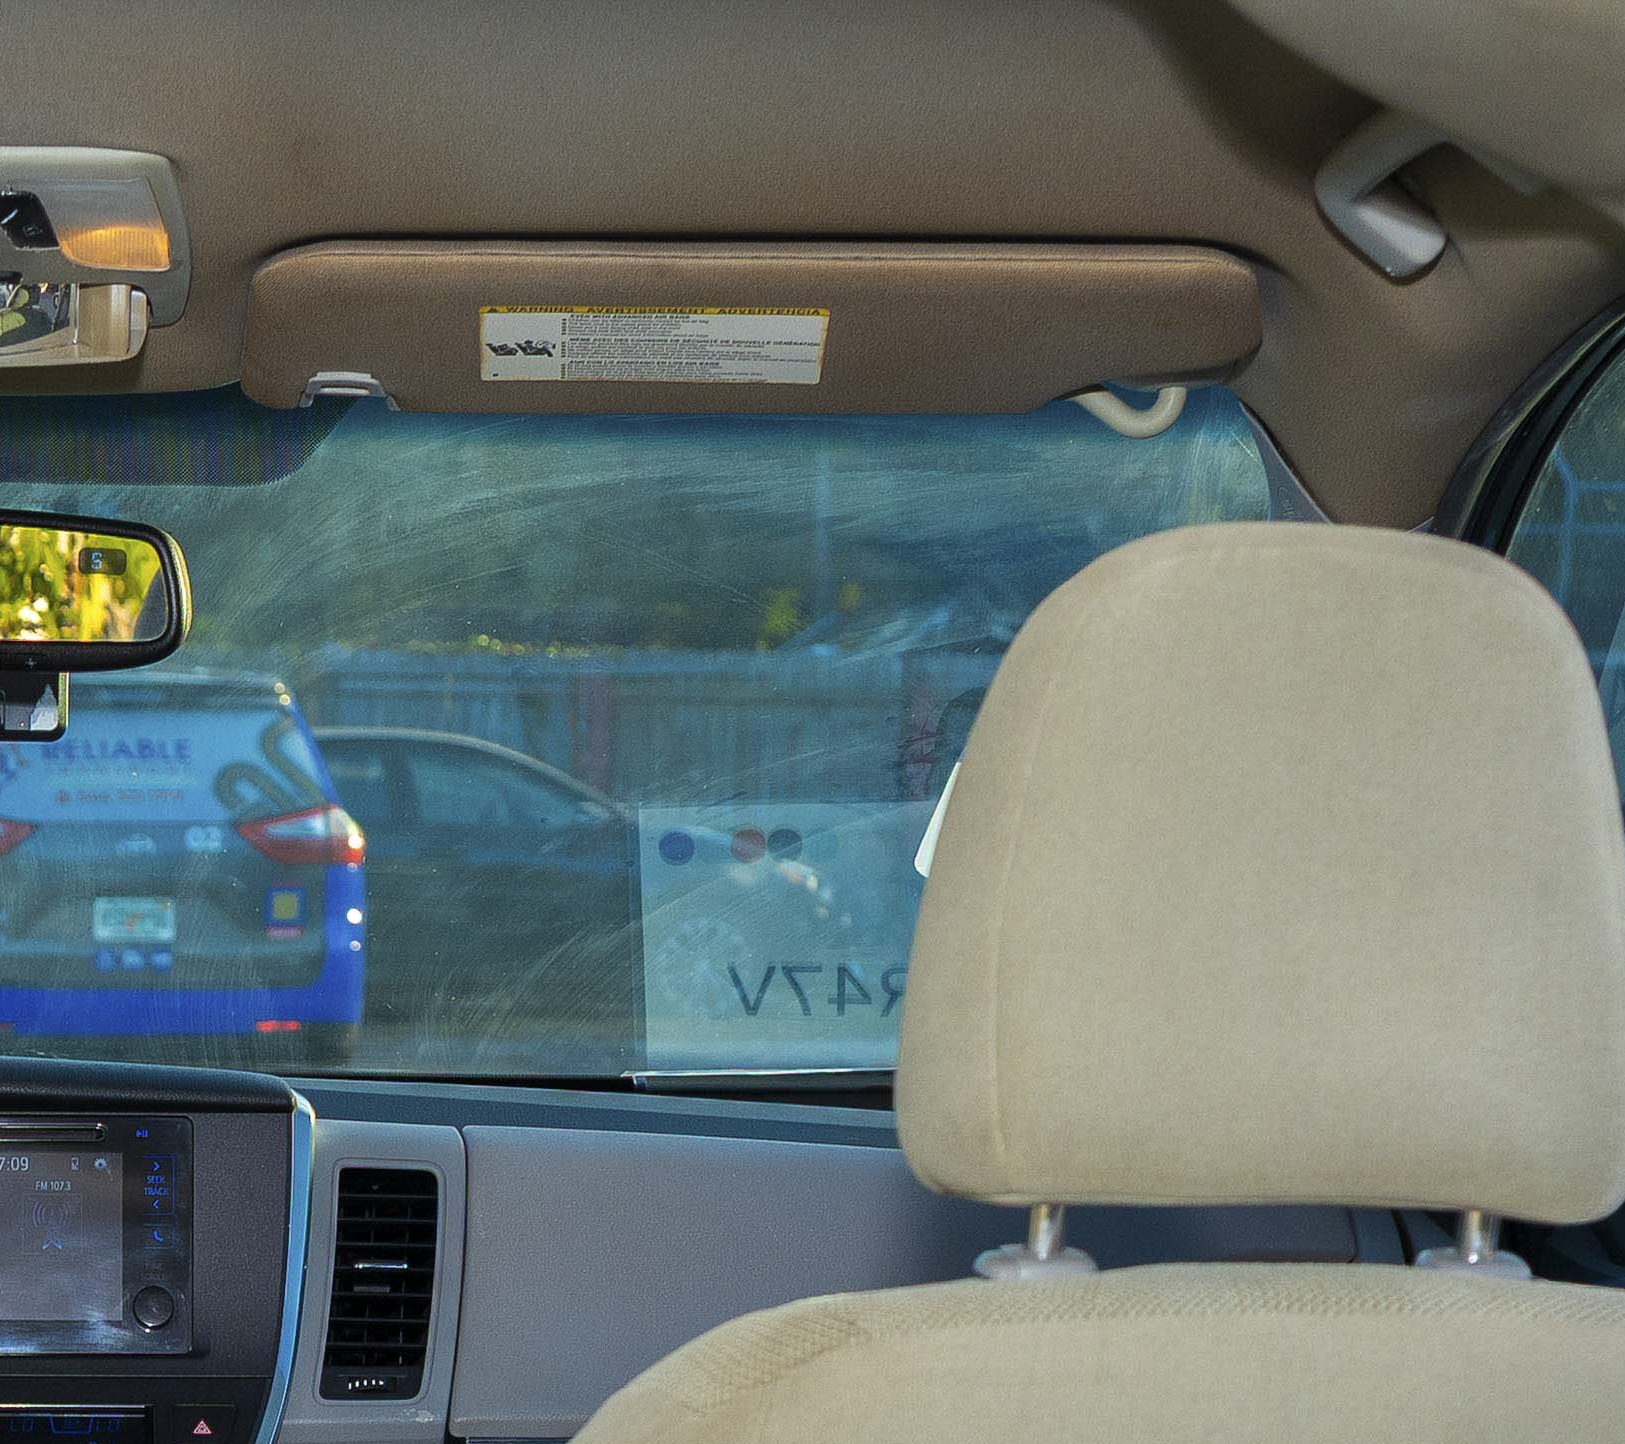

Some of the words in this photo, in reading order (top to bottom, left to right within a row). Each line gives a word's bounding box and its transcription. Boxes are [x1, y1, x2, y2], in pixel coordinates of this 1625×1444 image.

[587, 306, 706, 314] AVERTISSEMENT
[146, 1175, 166, 1185] SEEK
[35, 1181, 48, 1192] FM
[143, 1187, 169, 1197] TRACK
